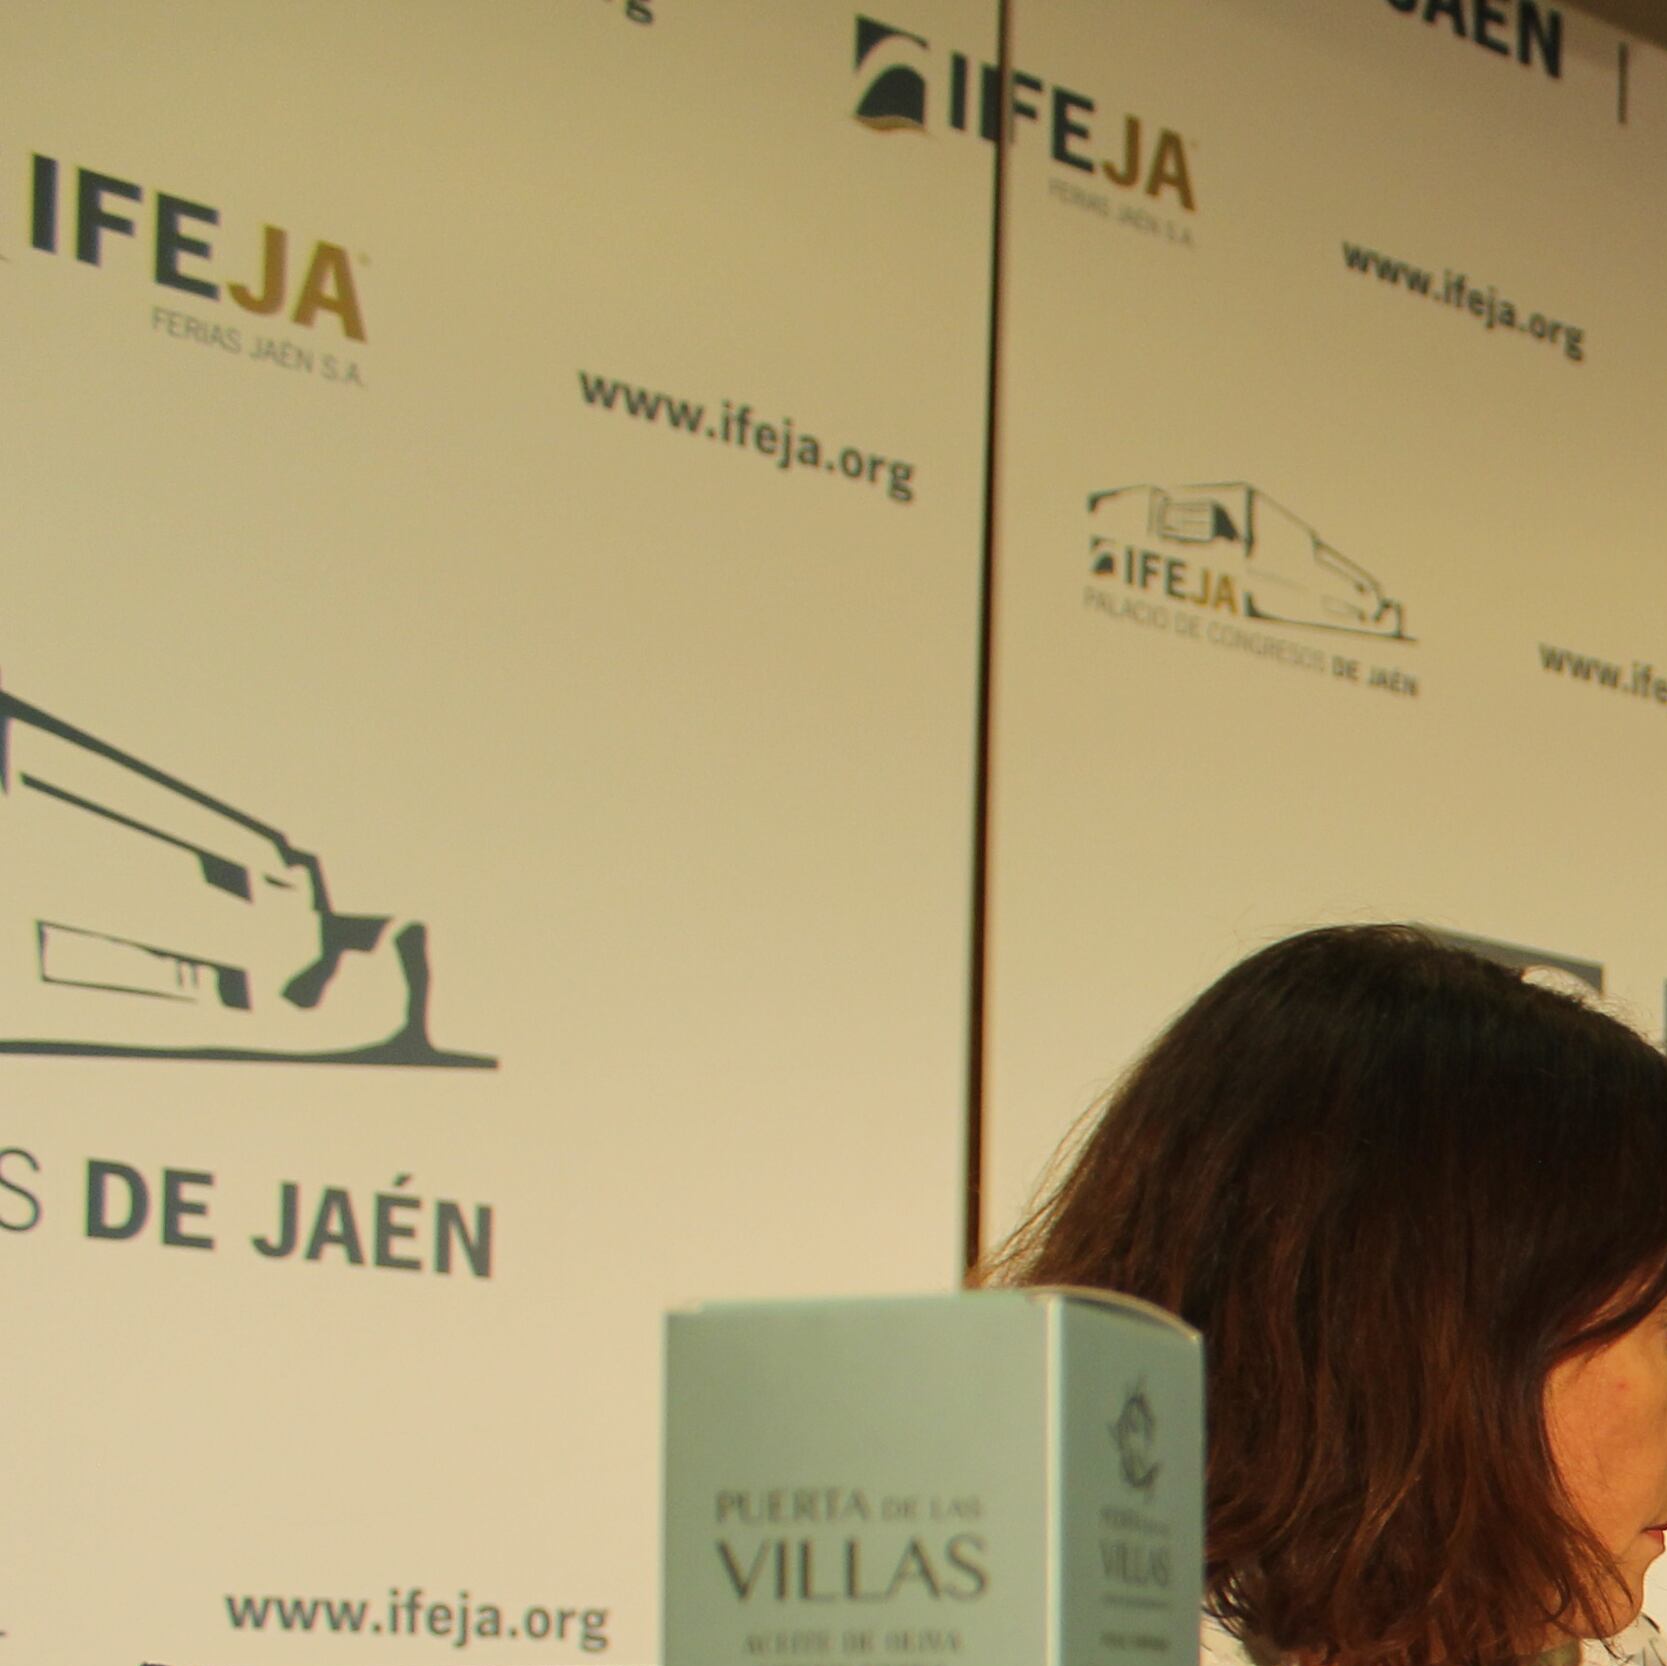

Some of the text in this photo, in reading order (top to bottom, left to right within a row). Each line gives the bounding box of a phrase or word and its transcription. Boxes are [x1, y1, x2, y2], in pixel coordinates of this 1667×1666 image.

[949, 52, 1196, 213] IFEJA
[29, 151, 369, 342] IFEJA
[1343, 240, 1585, 362] www.ifeja.org
[151, 306, 242, 355] FERIAS
[249, 336, 314, 378] JAÉN
[577, 370, 915, 503] www.ifeja.org
[1124, 545, 1239, 617] IFEJA
[1084, 586, 1168, 632] PALACIO
[1331, 654, 1360, 682] DE
[1366, 665, 1419, 698] JAÉN
[84, 1157, 216, 1251] DE
[251, 1174, 495, 1280] JAÉN
[715, 1486, 872, 1525] PUERTA
[224, 1587, 611, 1653] www.ifeja.org
[714, 1531, 991, 1604] VILLAS
